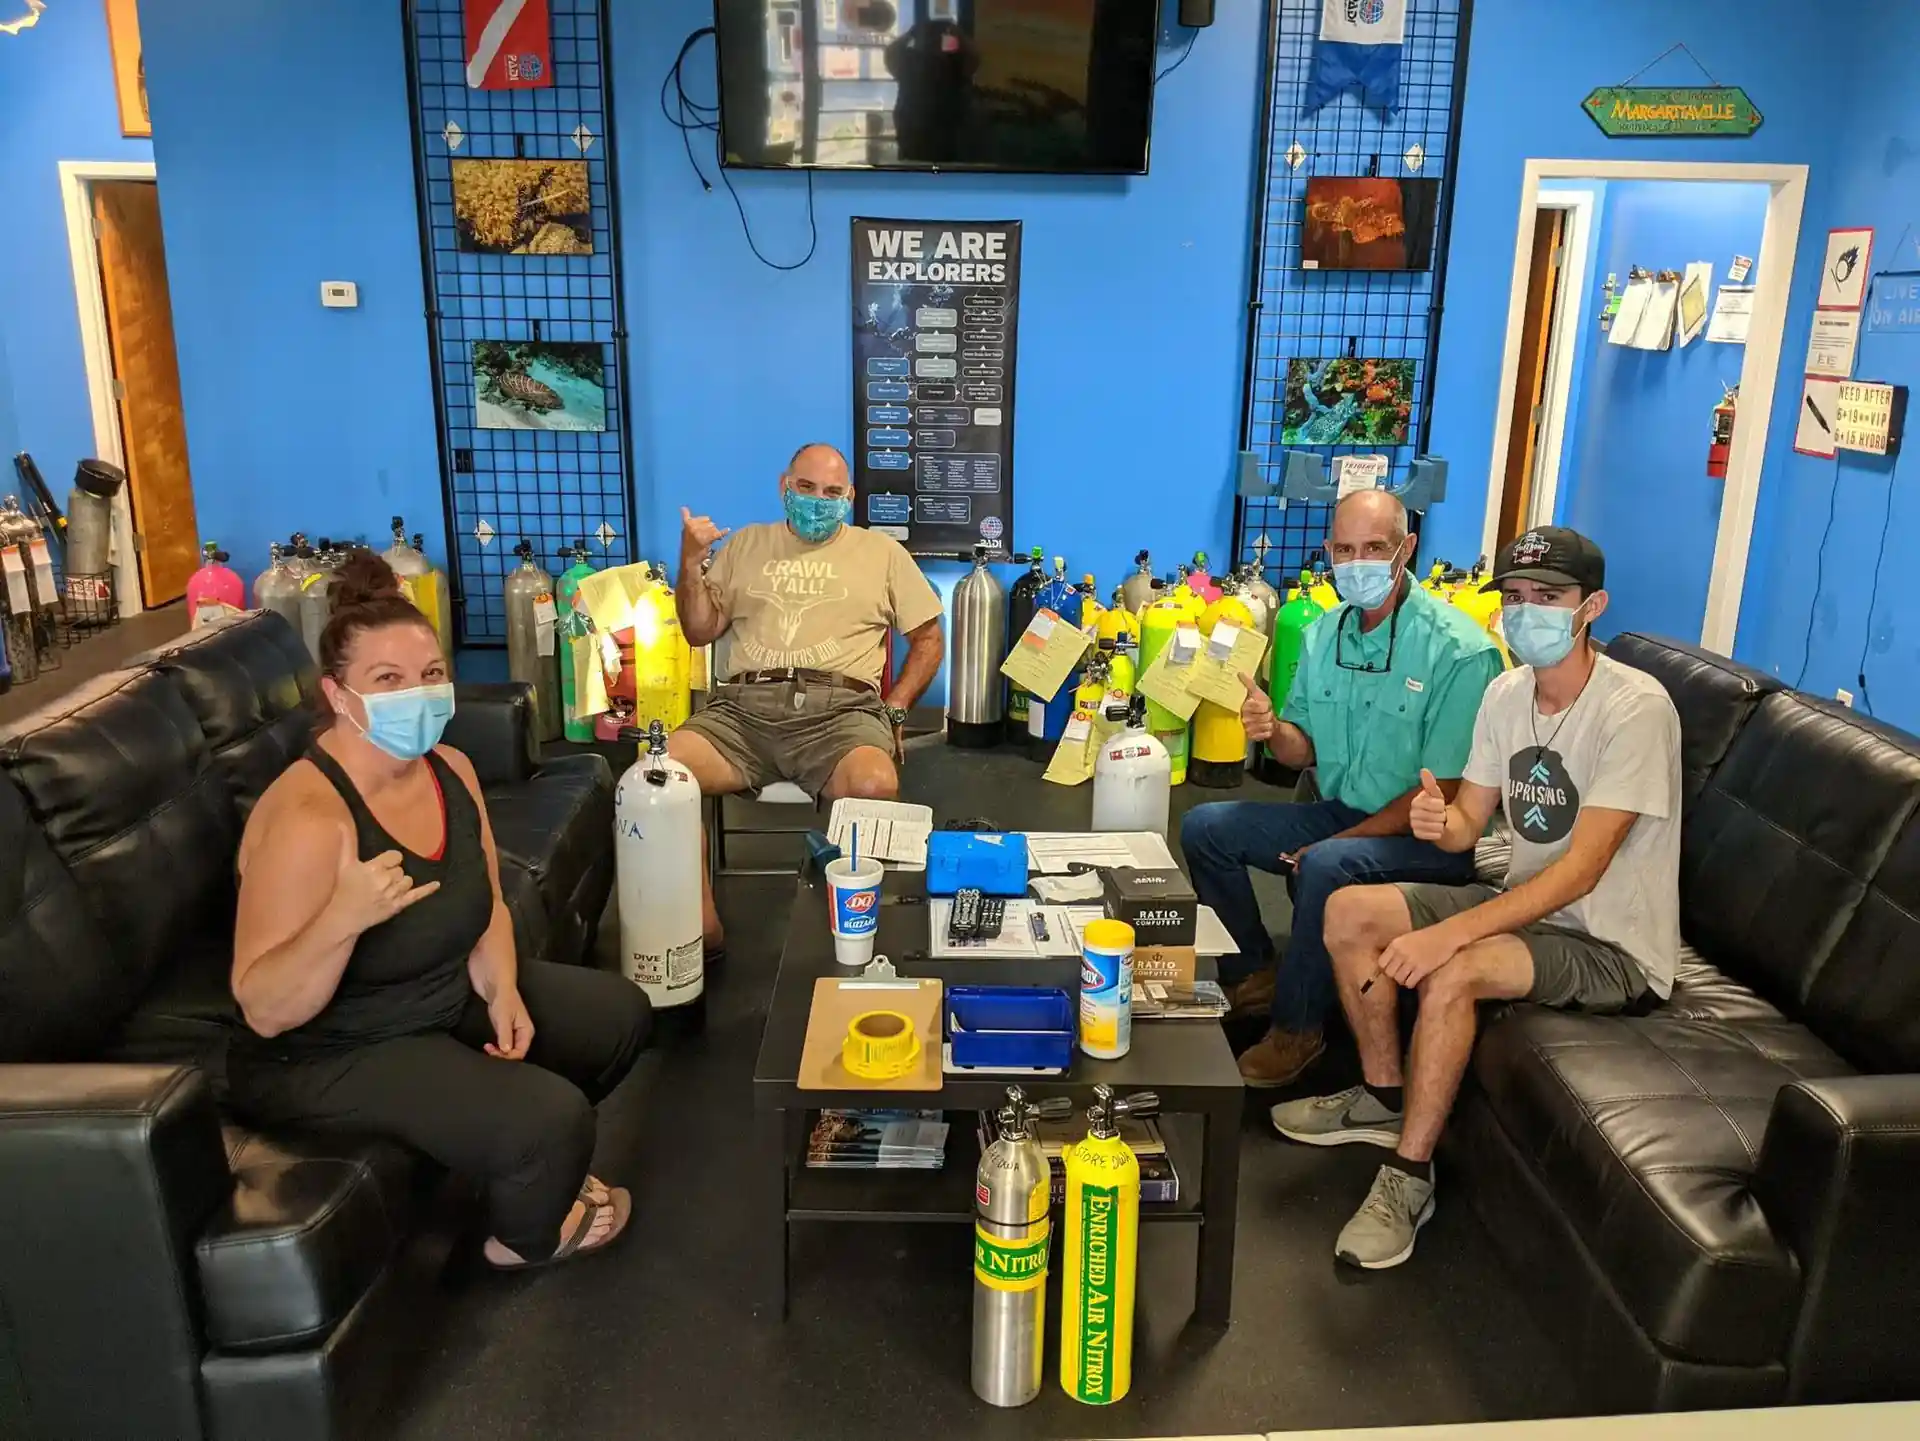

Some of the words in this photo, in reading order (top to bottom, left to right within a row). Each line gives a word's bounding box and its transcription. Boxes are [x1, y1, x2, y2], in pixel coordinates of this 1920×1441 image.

[508, 54, 519, 81] PADI
[867, 229, 924, 259] WE
[934, 231, 1007, 260] ARE
[868, 261, 1006, 283] EXPLORERS
[1839, 385, 1860, 402] NEED
[1864, 388, 1891, 405] AFTER
[1858, 431, 1886, 450] HYDRO
[763, 559, 839, 579] CRAWL
[771, 576, 826, 595] Y'ALL!
[1508, 779, 1567, 806] UPRISING
[1140, 910, 1178, 919] RATIO
[633, 952, 661, 962] DIVE
[1137, 961, 1176, 969] RATIO
[1074, 1146, 1108, 1169] STORE
[1088, 1192, 1112, 1286] ENRICHED
[976, 1240, 985, 1265] IR
[989, 1247, 1047, 1274] NITRO
[1087, 1286, 1109, 1324] AIR
[1085, 1328, 1108, 1397] NITROX
